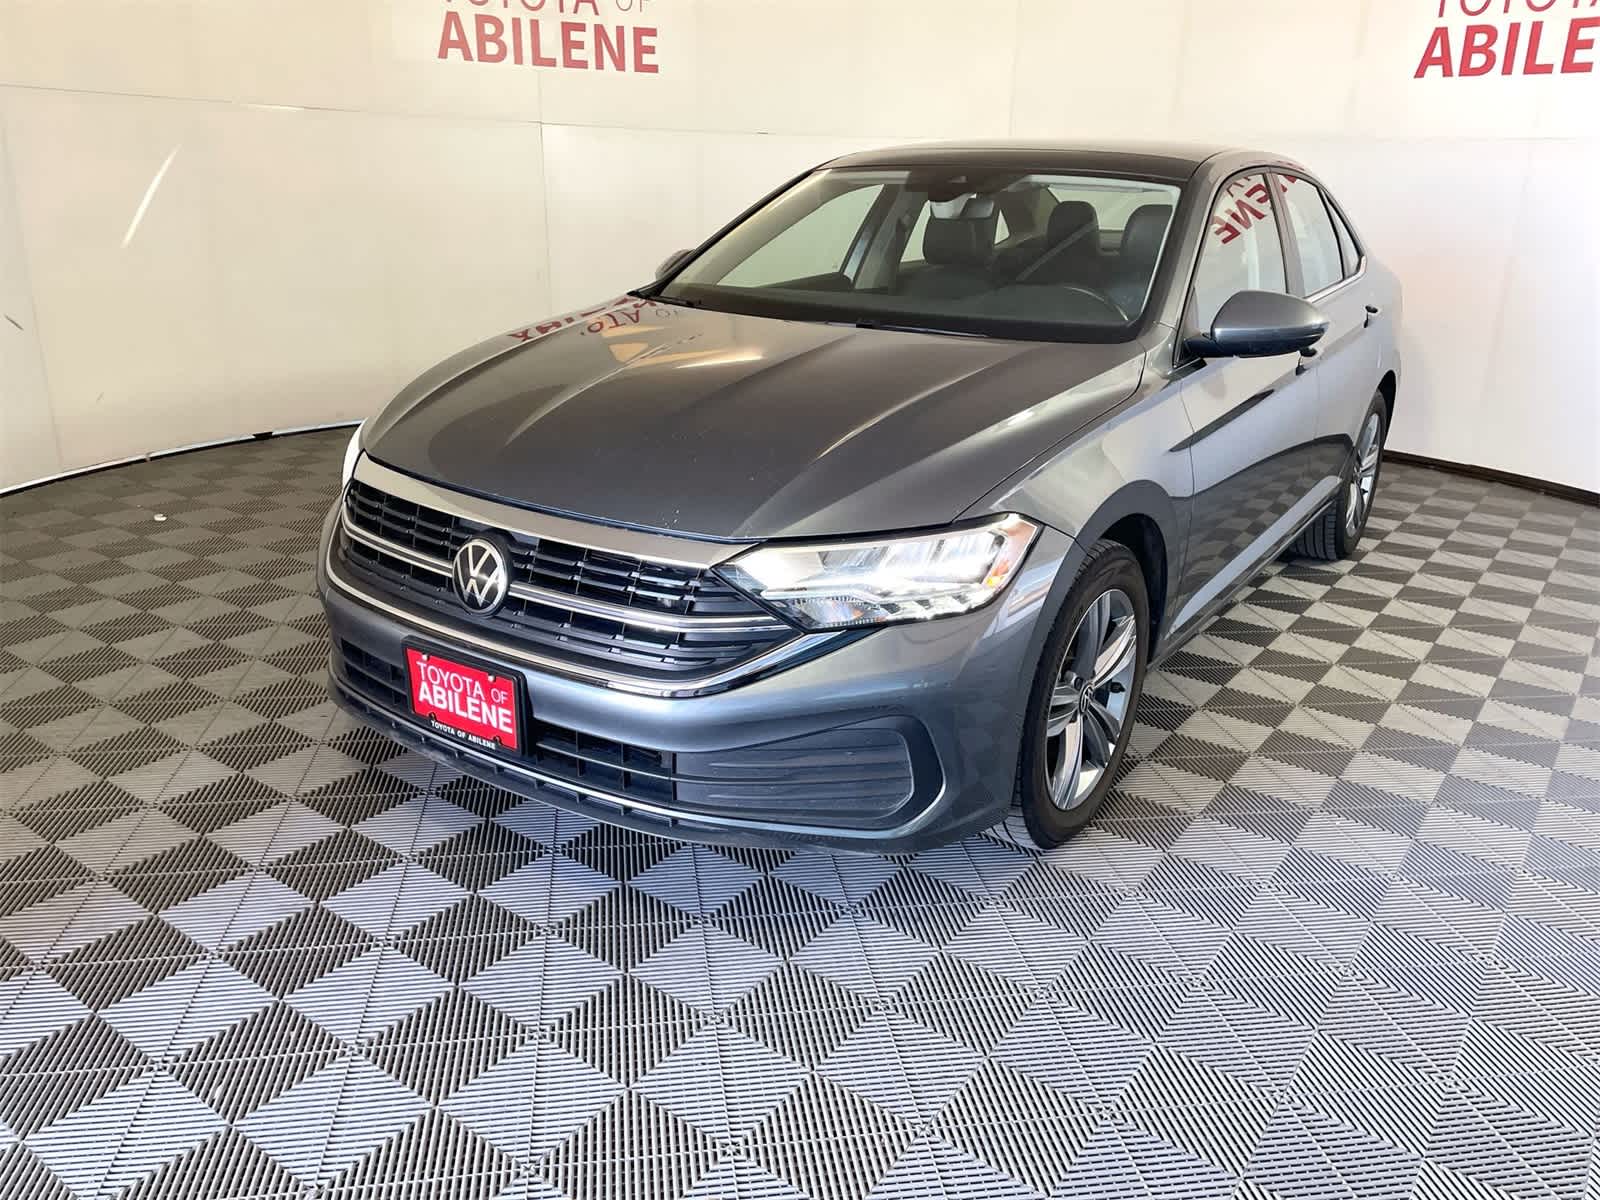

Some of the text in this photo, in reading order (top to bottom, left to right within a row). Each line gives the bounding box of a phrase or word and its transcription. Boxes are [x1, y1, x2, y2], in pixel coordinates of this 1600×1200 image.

[438, 10, 659, 74] ABILENE
[416, 661, 508, 704] TOYOTA OF
[418, 681, 513, 734] ABILENE
[431, 719, 496, 750] TOYOTA OF ABILENE
